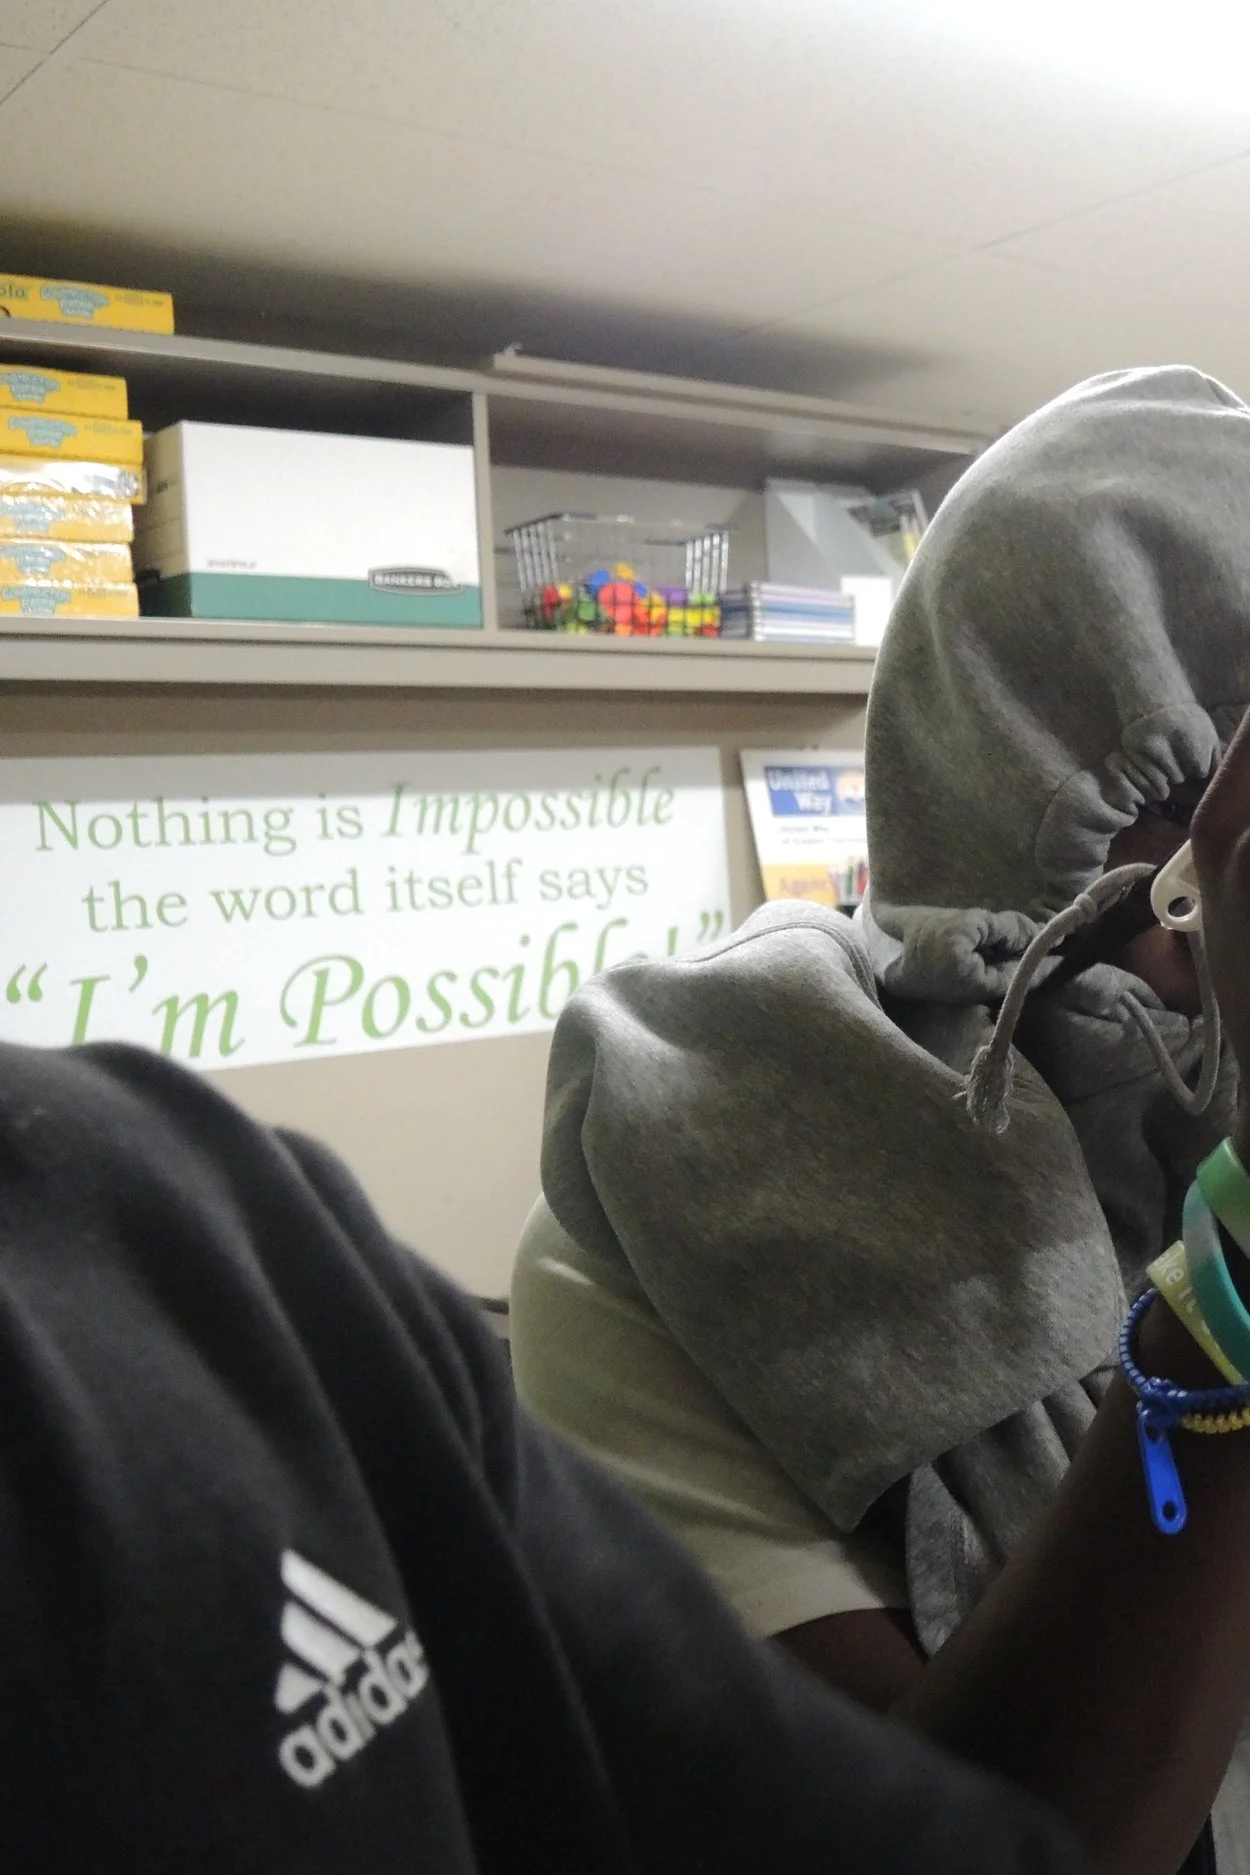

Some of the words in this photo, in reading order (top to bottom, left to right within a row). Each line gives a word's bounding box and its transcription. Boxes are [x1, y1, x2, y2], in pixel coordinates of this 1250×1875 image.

[767, 769, 830, 791] United
[793, 792, 833, 816] Way
[35, 795, 298, 857] Nothing
[317, 792, 364, 838] is
[381, 766, 675, 853] Impossible
[82, 879, 188, 932] the
[211, 867, 364, 924] word
[387, 858, 523, 911] itself
[539, 863, 649, 910] says
